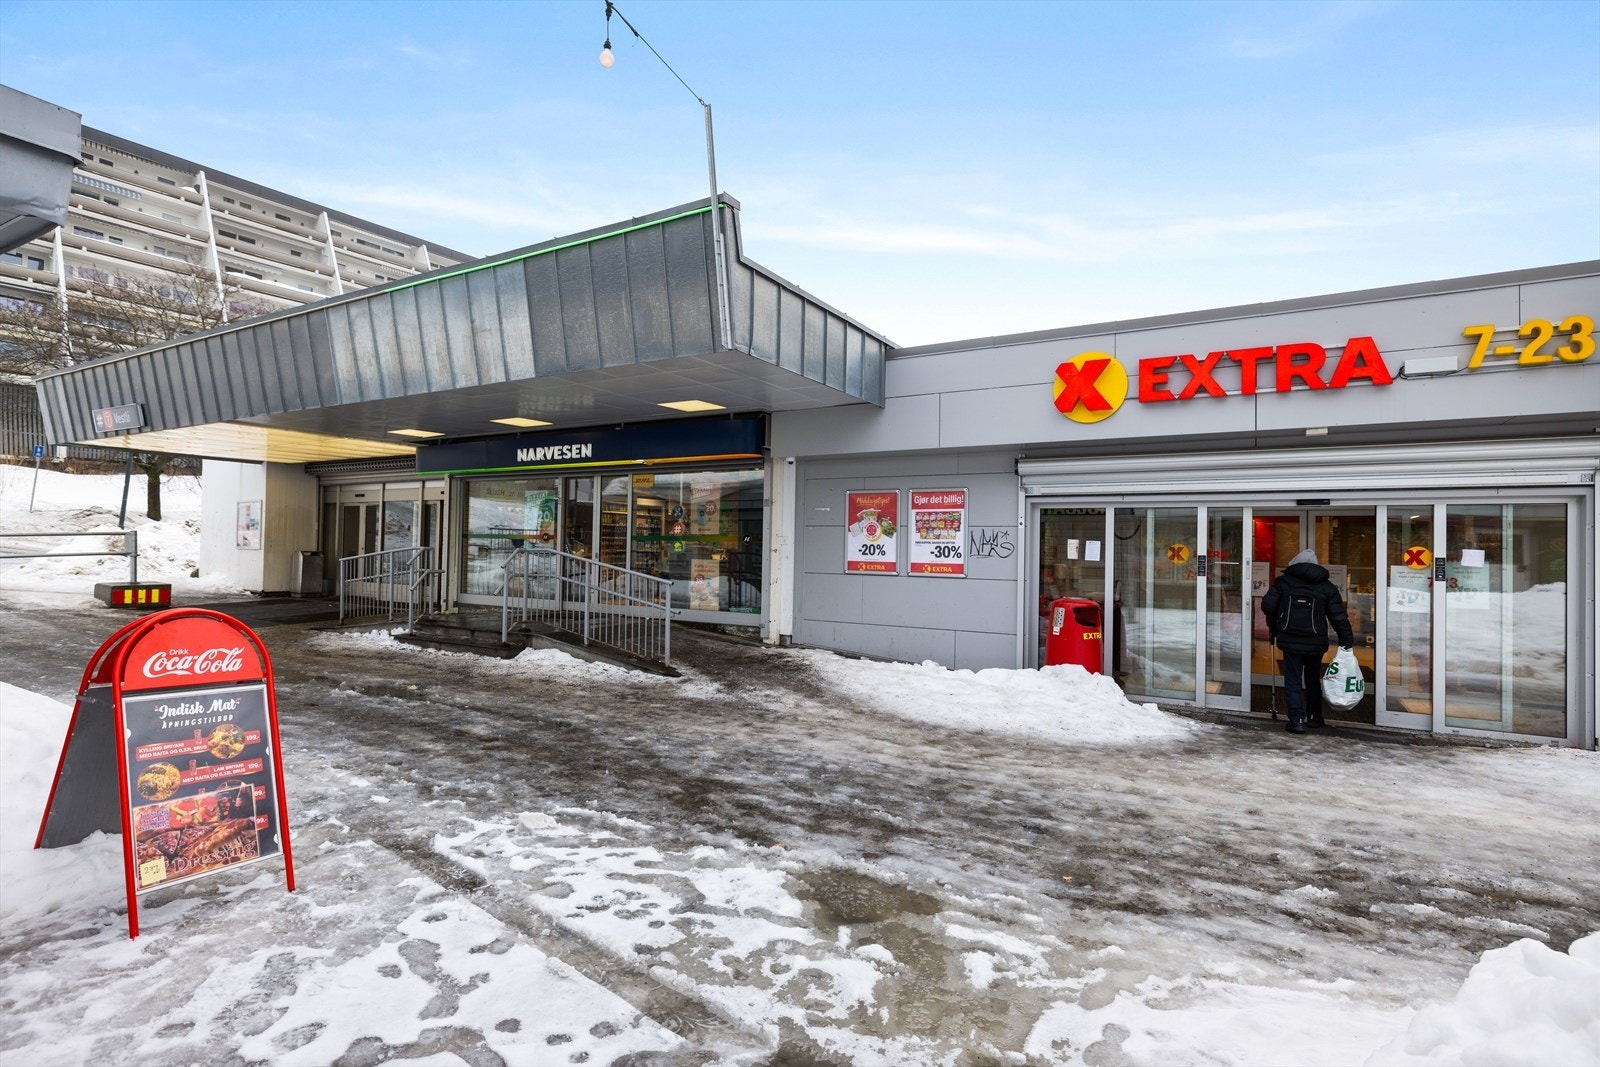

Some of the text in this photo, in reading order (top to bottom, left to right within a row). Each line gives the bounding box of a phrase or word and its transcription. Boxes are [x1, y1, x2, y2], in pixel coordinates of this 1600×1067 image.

[1463, 315, 1596, 371] 7-23
[1138, 336, 1393, 403] EXTRA
[517, 443, 592, 462] NARVESEN
[914, 496, 929, 506] Gjør
[943, 494, 964, 505] billig!
[858, 544, 886, 556] -20%
[930, 545, 962, 558] -30%
[142, 647, 245, 678] Coca-Cola
[159, 699, 237, 720] Indisk Mat
[162, 714, 234, 729] ÅPNINGSTILBUD
[139, 745, 163, 753] KYLLING
[173, 840, 257, 872] Dressing
